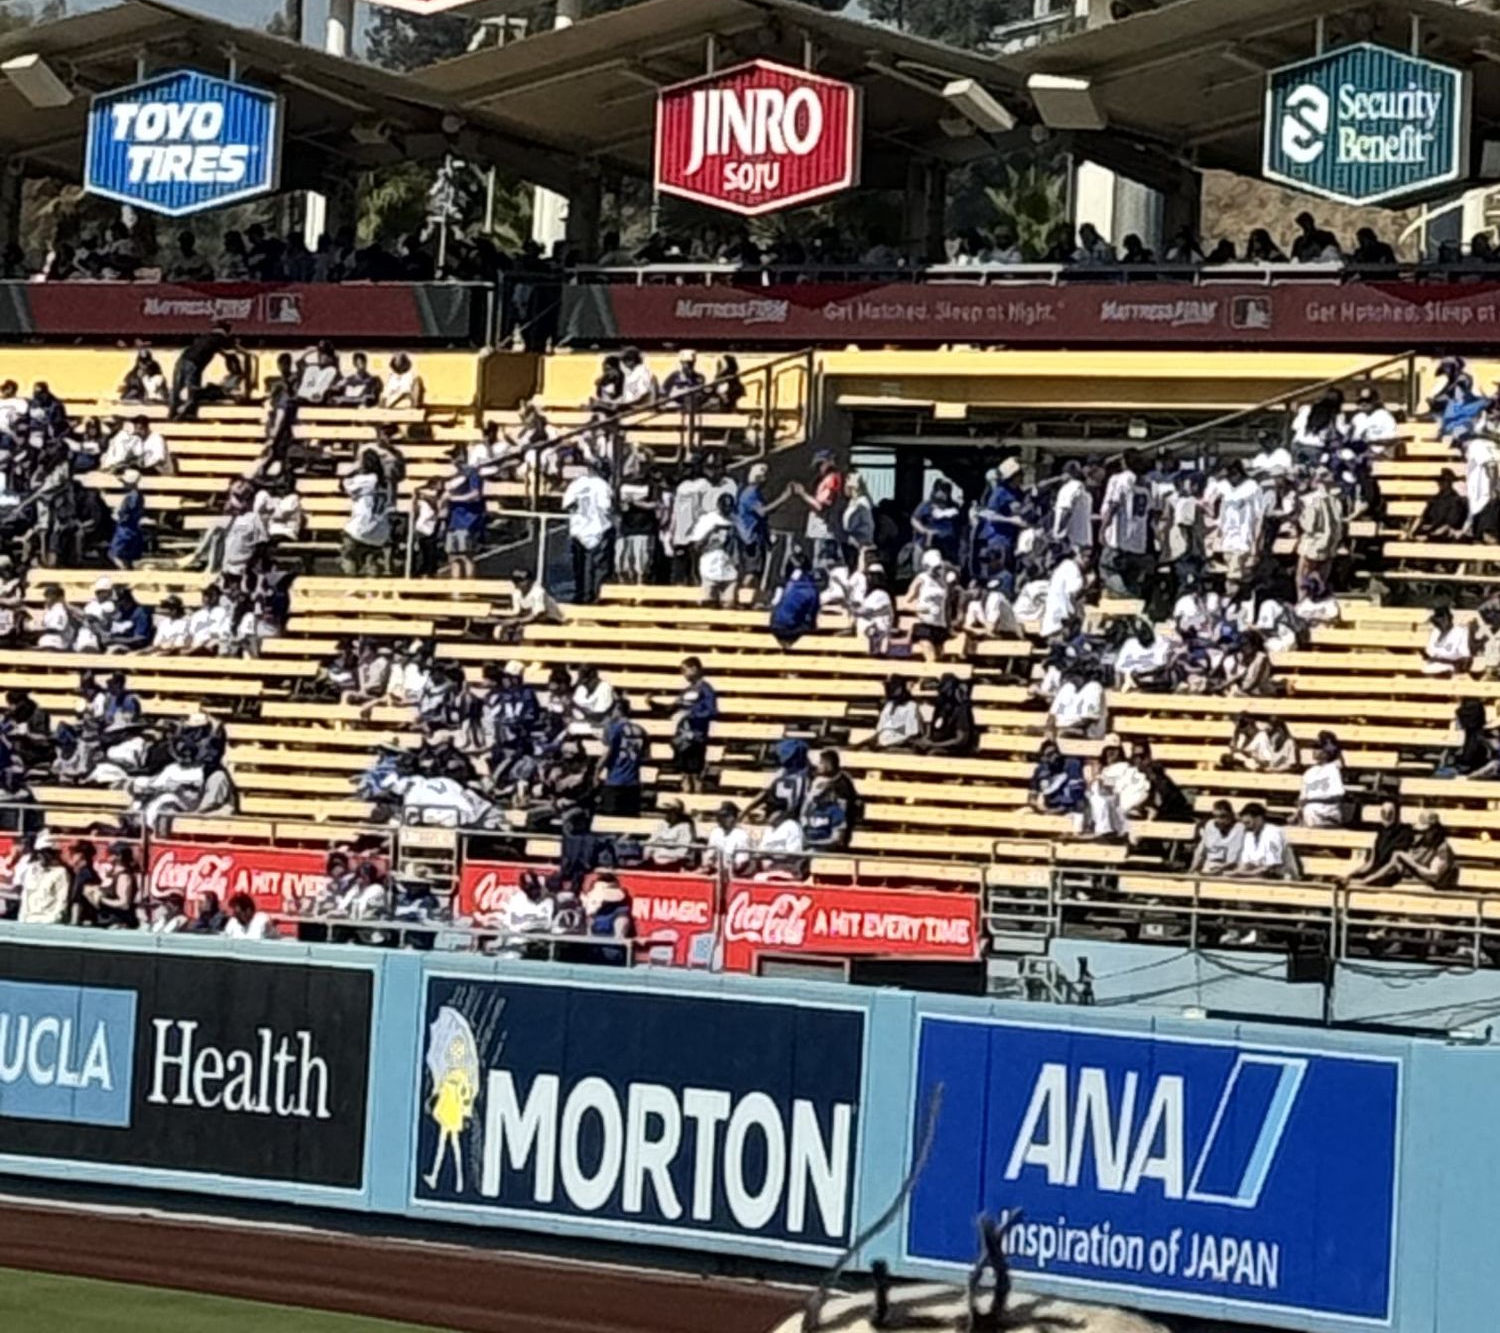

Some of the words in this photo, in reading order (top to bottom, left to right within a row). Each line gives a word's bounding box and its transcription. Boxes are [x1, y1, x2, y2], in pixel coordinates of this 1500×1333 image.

[111, 102, 224, 141] TOYO
[683, 87, 823, 175] JINRO
[1338, 83, 1440, 130] Security
[127, 144, 249, 184] TIRES
[1337, 127, 1428, 163] Benefit
[814, 908, 828, 936] A
[830, 909, 861, 938] HIT
[863, 912, 921, 941] EVERY
[922, 916, 971, 945] TIME
[0, 1013, 113, 1091] UCLA
[148, 1018, 331, 1119] Health
[481, 1070, 851, 1237] MORTON
[1005, 1063, 1184, 1199] ANA
[1000, 1210, 1143, 1271] Inspiration
[1150, 1228, 1180, 1274] of
[1184, 1233, 1280, 1290] JAPAN
